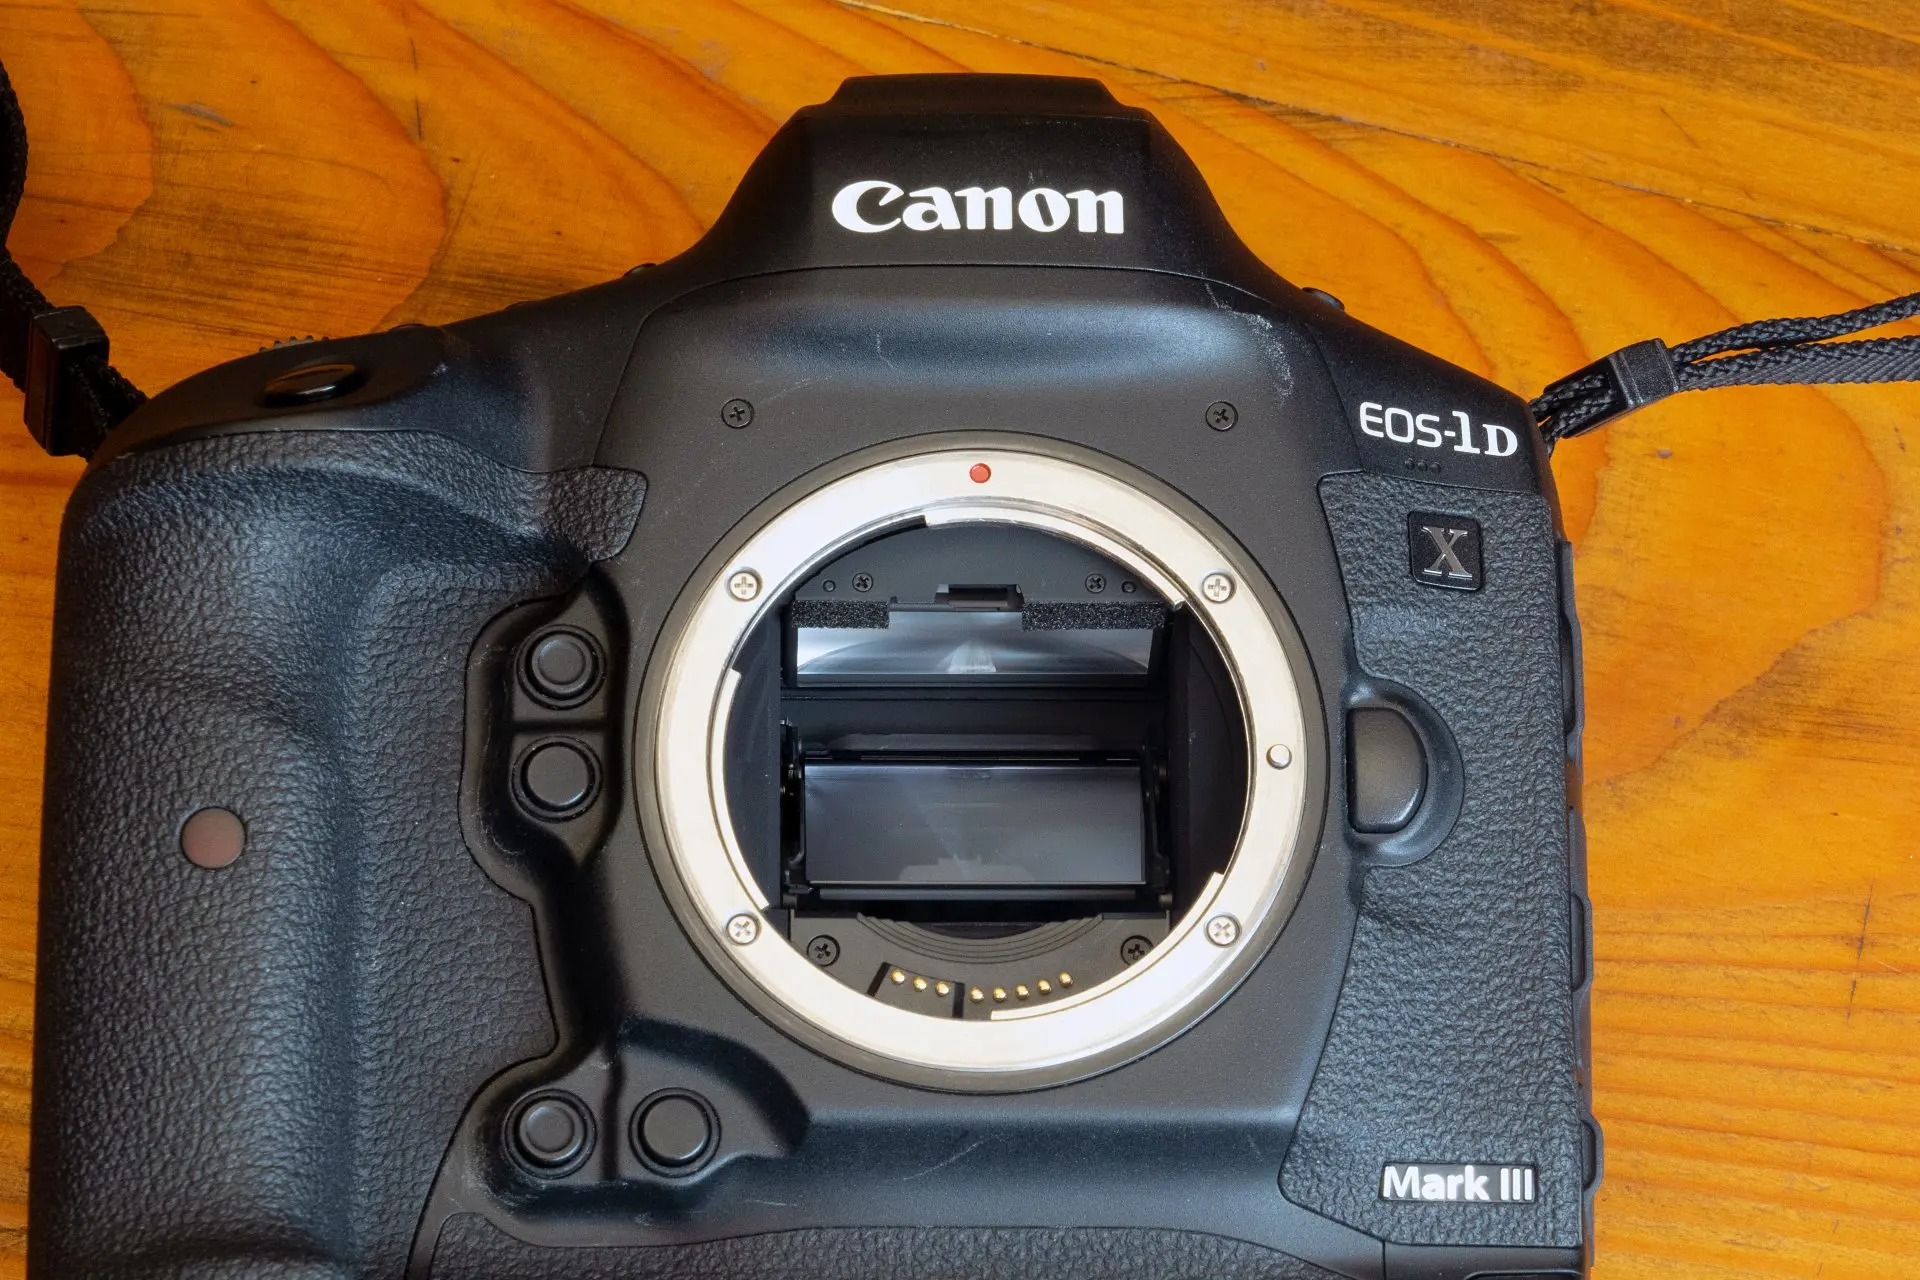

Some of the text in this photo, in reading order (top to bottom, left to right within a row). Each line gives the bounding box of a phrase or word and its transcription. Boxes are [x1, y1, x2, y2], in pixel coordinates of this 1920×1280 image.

[832, 180, 1125, 234] Canon
[1360, 402, 1519, 457] EOS-1D
[1421, 526, 1473, 579] X
[1383, 1165, 1534, 1202] Mark III
